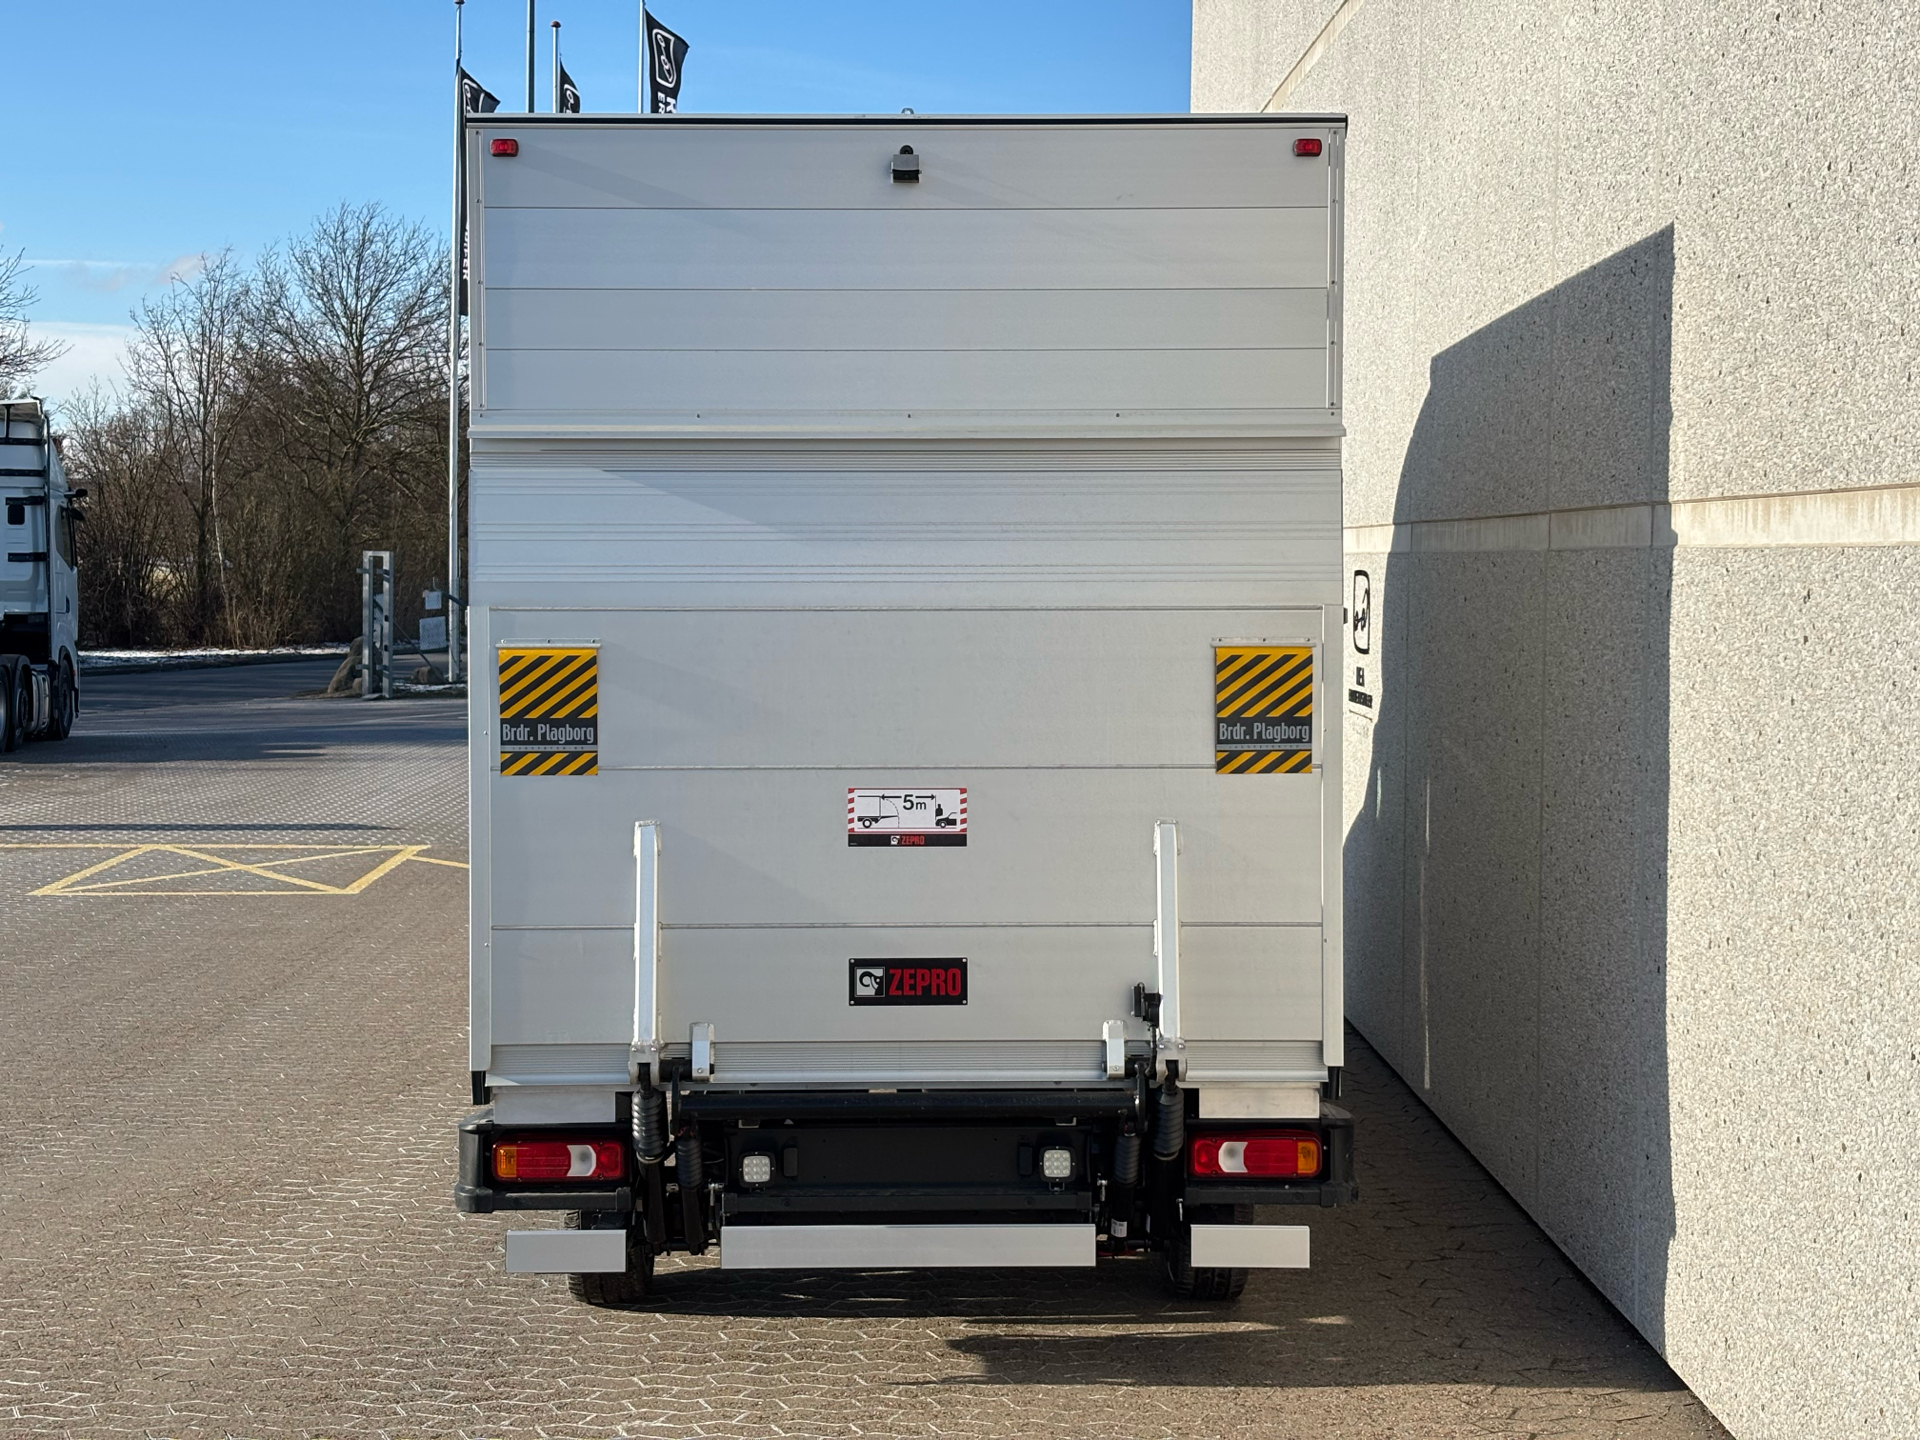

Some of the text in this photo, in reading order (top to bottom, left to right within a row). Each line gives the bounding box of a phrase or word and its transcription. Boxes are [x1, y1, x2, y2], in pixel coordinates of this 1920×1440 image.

[502, 723, 594, 744] Brdr. Plagborg
[1219, 722, 1310, 743] Brdr. Plagborg
[901, 835, 926, 846] ZEPRO
[888, 968, 962, 996] ZEPRO
